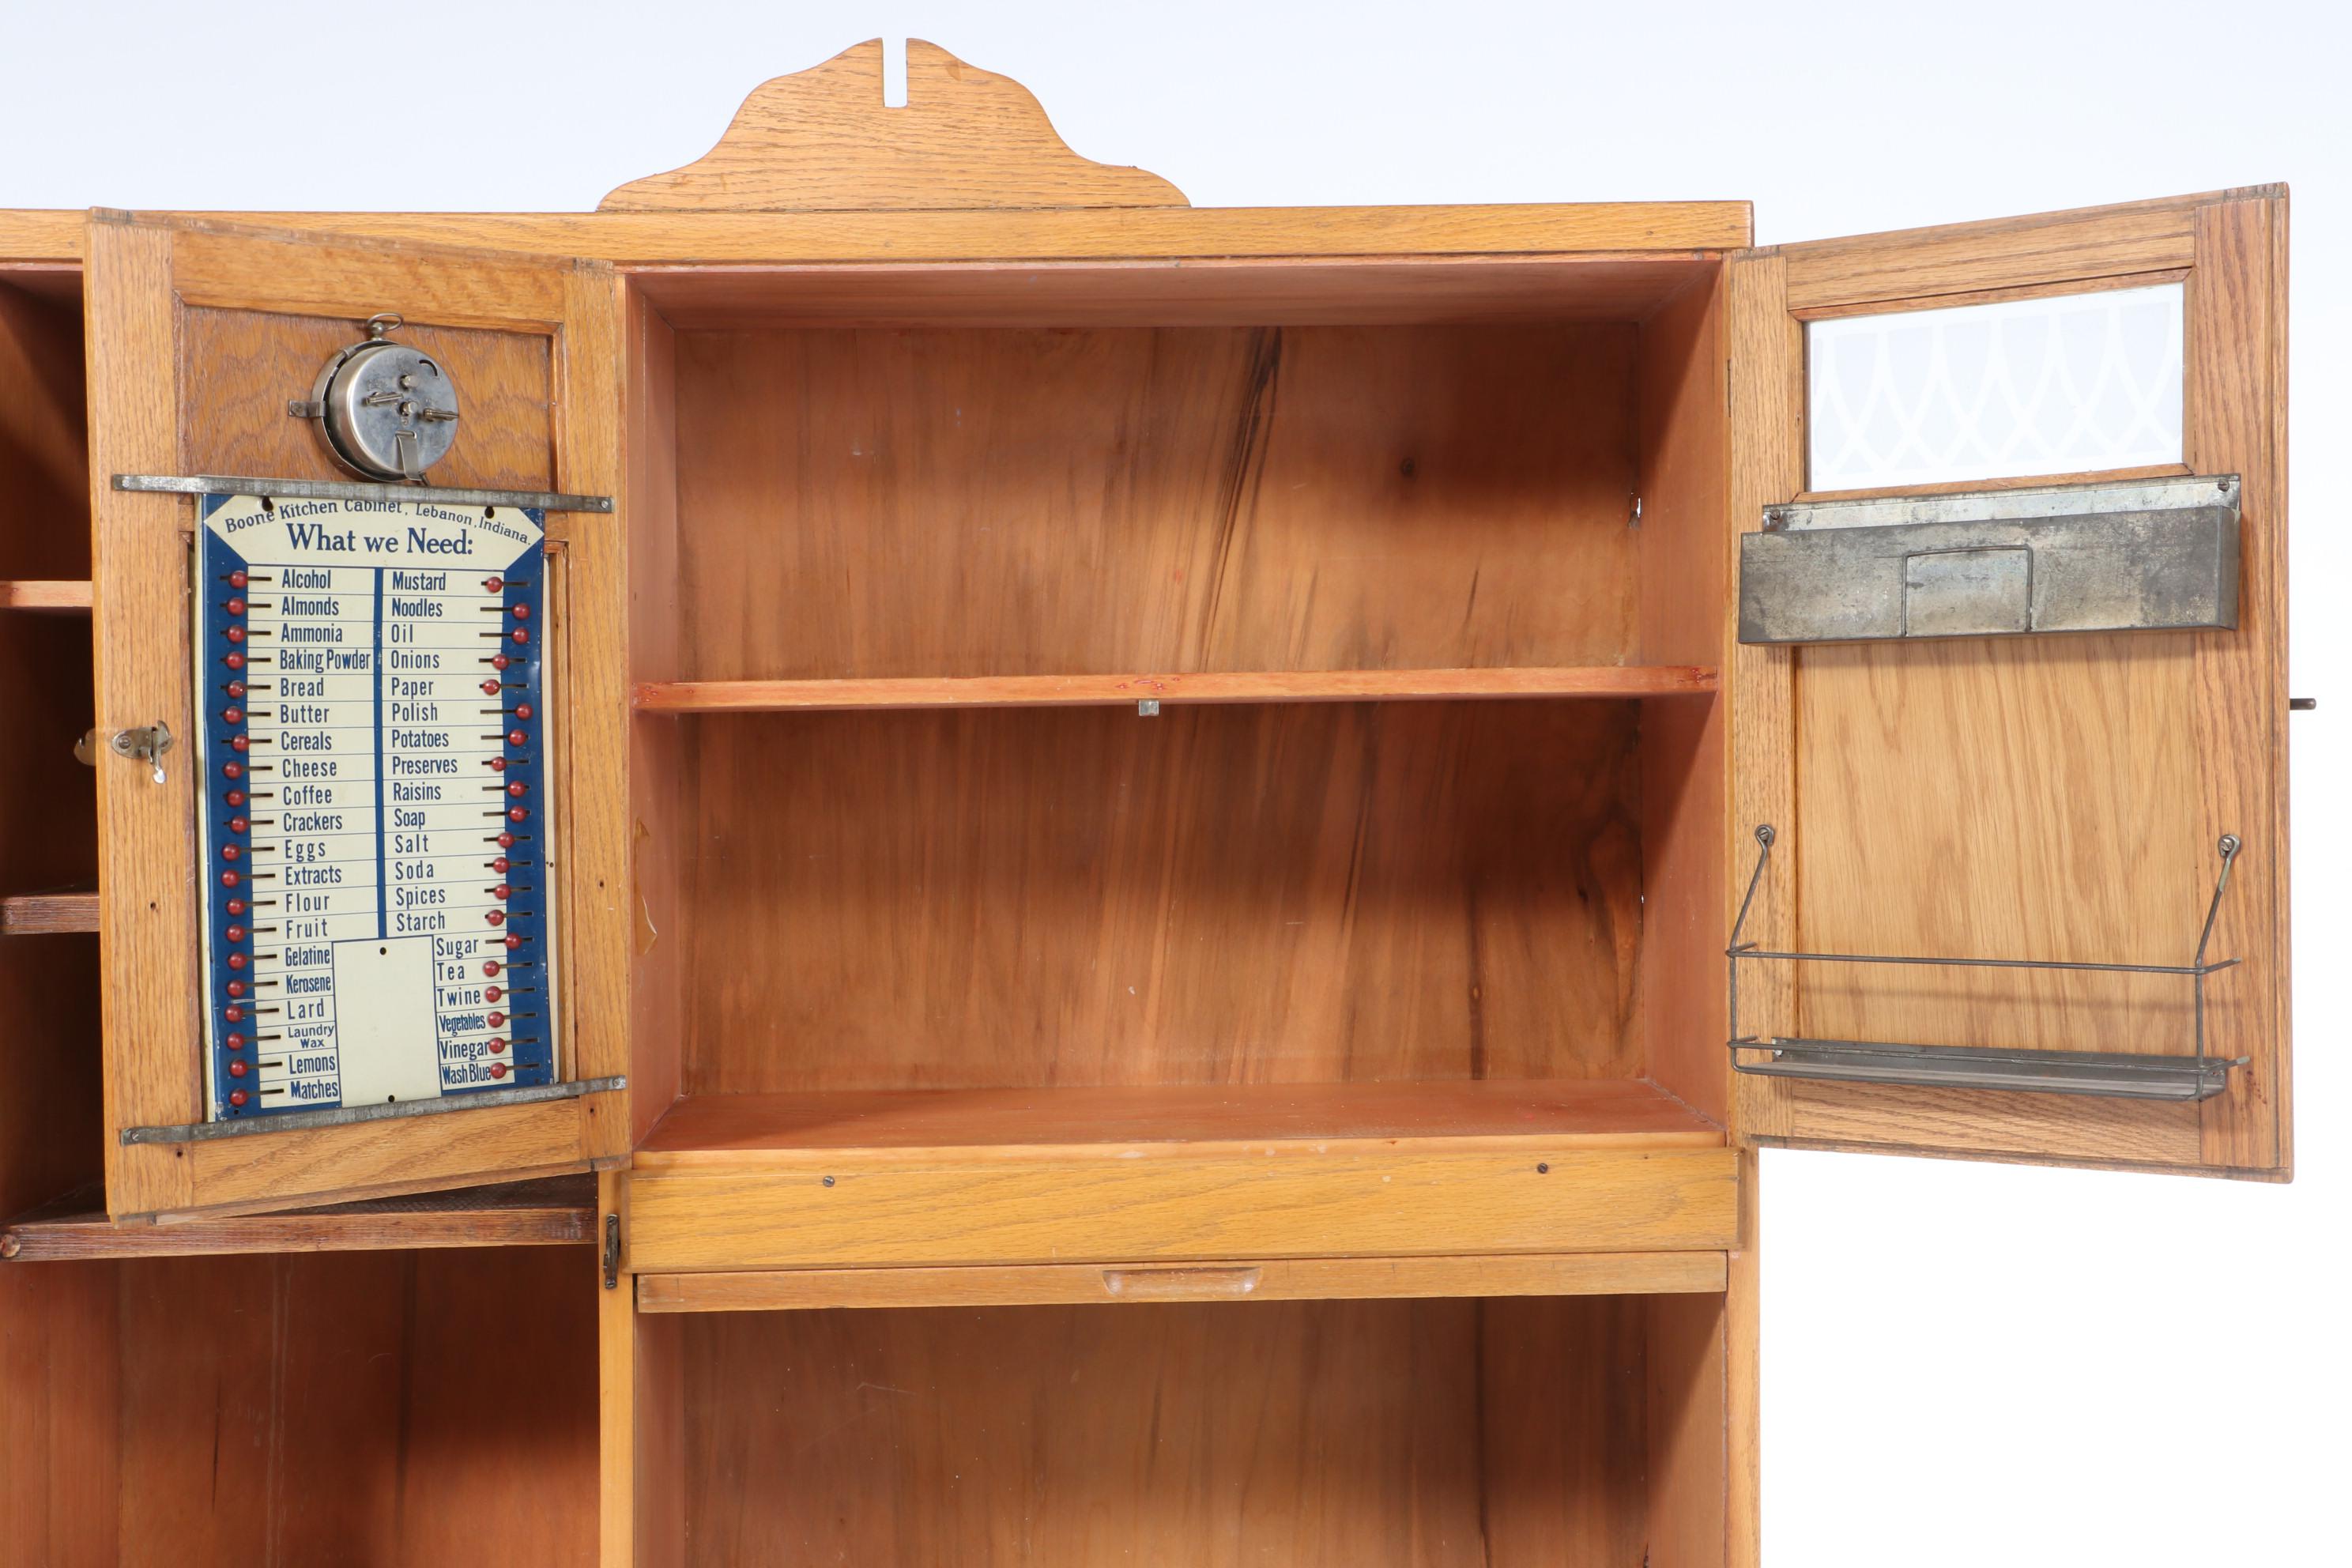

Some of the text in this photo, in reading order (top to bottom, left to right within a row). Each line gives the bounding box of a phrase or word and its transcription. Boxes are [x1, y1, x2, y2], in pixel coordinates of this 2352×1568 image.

[225, 510, 275, 533] Boone
[280, 502, 338, 520] Kitchen
[478, 517, 532, 545] Indiana.
[287, 523, 473, 555] What we Need:
[282, 569, 331, 589] Alcohol
[392, 571, 446, 591] Mustard
[282, 596, 339, 616] Almonds
[392, 597, 442, 617] Noodles
[281, 624, 342, 643] Ammonia
[391, 624, 413, 643] Oil
[280, 650, 371, 673] Baking Powder
[391, 650, 439, 669] Onions
[281, 677, 324, 697] Bread
[391, 677, 434, 699] Paper
[281, 704, 330, 723] Butter
[391, 702, 438, 722] Polish
[281, 730, 332, 751] Cereals
[391, 729, 449, 748] Potatoes
[283, 758, 337, 778] Cheese
[392, 756, 458, 775] Preserves
[284, 786, 332, 805] Coffee
[394, 781, 441, 801] Raisins
[284, 812, 342, 832] Crackers
[394, 808, 425, 827] Soap
[285, 839, 326, 862] Eggs
[395, 834, 428, 854] Salt
[285, 865, 341, 886] Extracts
[395, 860, 434, 880] Soda
[286, 893, 330, 913] Flour
[396, 887, 446, 910] Spices
[286, 919, 328, 939] Fruit
[397, 910, 445, 932] Starch
[285, 946, 330, 967] Gelatine
[436, 935, 478, 959] Sugar
[438, 961, 465, 981] Tea
[286, 974, 331, 994] Kerosene
[438, 986, 481, 1007] Twine
[288, 999, 324, 1020] Lard
[288, 1023, 334, 1038] Laundry
[439, 1013, 485, 1037] Vegetables
[300, 1037, 324, 1049] Wax
[440, 1037, 489, 1062] Vinegar
[289, 1054, 335, 1075] Lemons
[442, 1063, 491, 1084] Wash Blue
[291, 1079, 338, 1099] Matches
